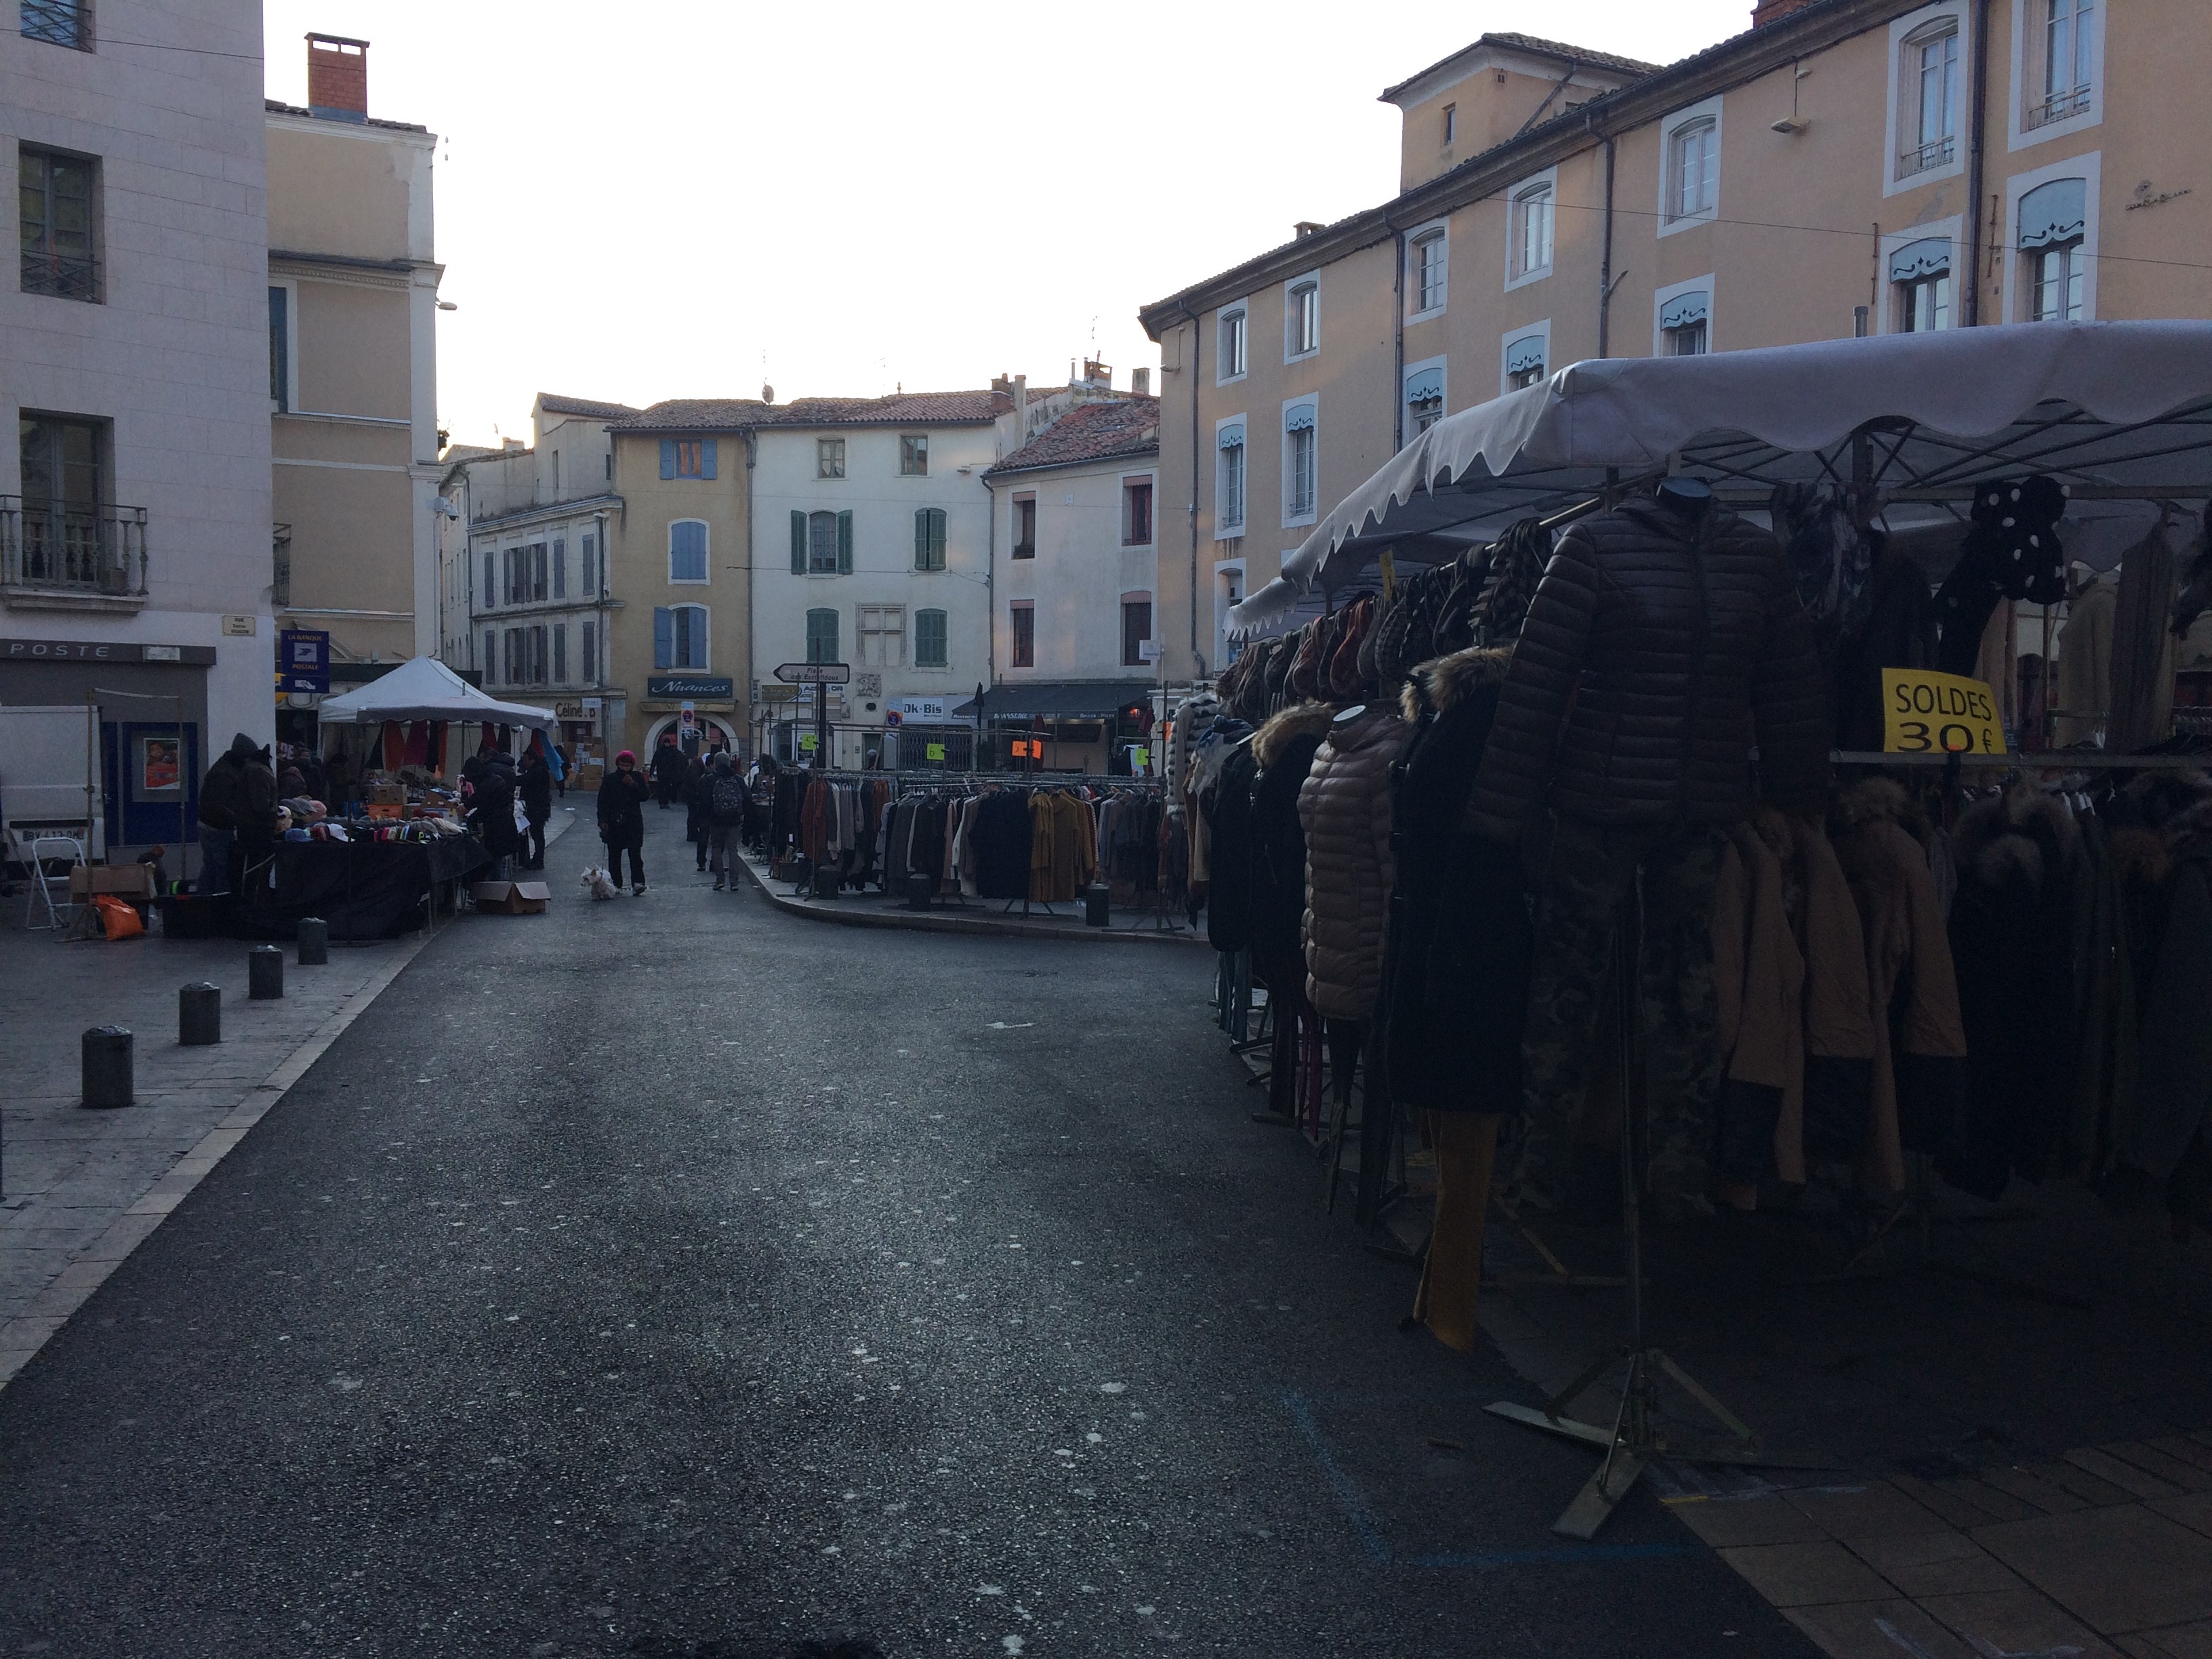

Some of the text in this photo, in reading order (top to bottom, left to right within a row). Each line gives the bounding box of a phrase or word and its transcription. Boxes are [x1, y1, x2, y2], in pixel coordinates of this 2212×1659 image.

[10, 644, 109, 657] POSTE
[651, 681, 729, 693] Nuances
[556, 702, 582, 718] Céline
[1896, 684, 1992, 722] SOLDES
